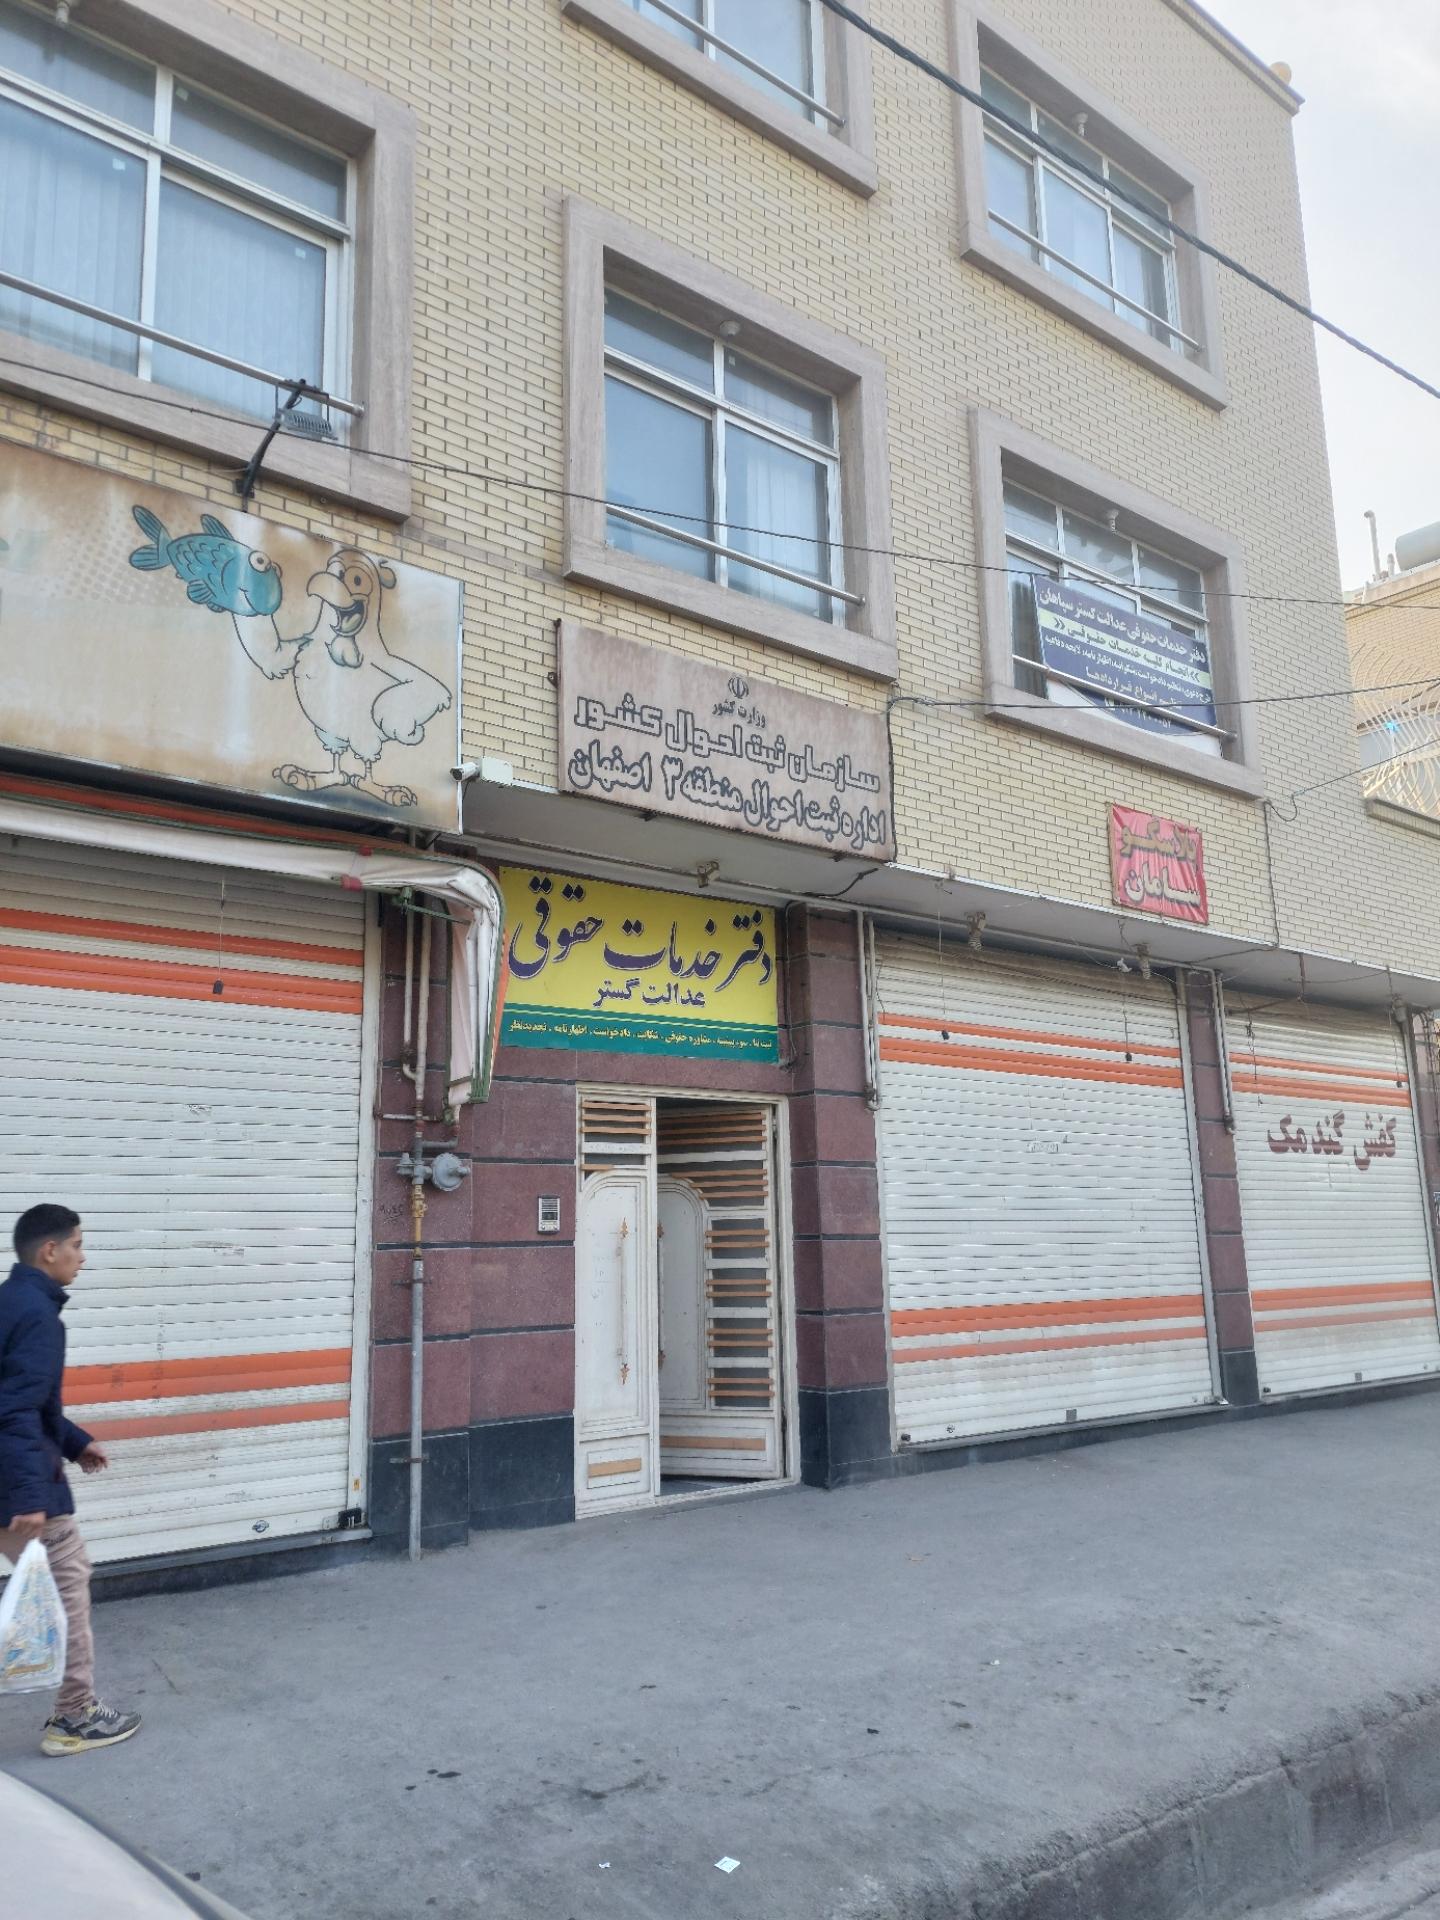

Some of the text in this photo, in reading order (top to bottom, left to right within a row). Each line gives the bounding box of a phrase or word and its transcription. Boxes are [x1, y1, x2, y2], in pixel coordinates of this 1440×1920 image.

[1097, 612, 1127, 631] عدالت
[1127, 623, 1157, 643] حقوقی
[711, 700, 767, 728] وزارت کشور
[568, 739, 652, 792] اصفهان
[574, 692, 880, 793] سازمان ثبت احوال کشور
[680, 767, 744, 812] منطقه
[744, 779, 803, 832] احوال
[804, 795, 840, 842] ثبت
[841, 806, 886, 850] اداره
[1124, 860, 1202, 909] سامان
[508, 876, 772, 992] دفتر خدمات حقوقی
[592, 977, 706, 1008] عدالت گستر
[1353, 1111, 1397, 1170] کفش
